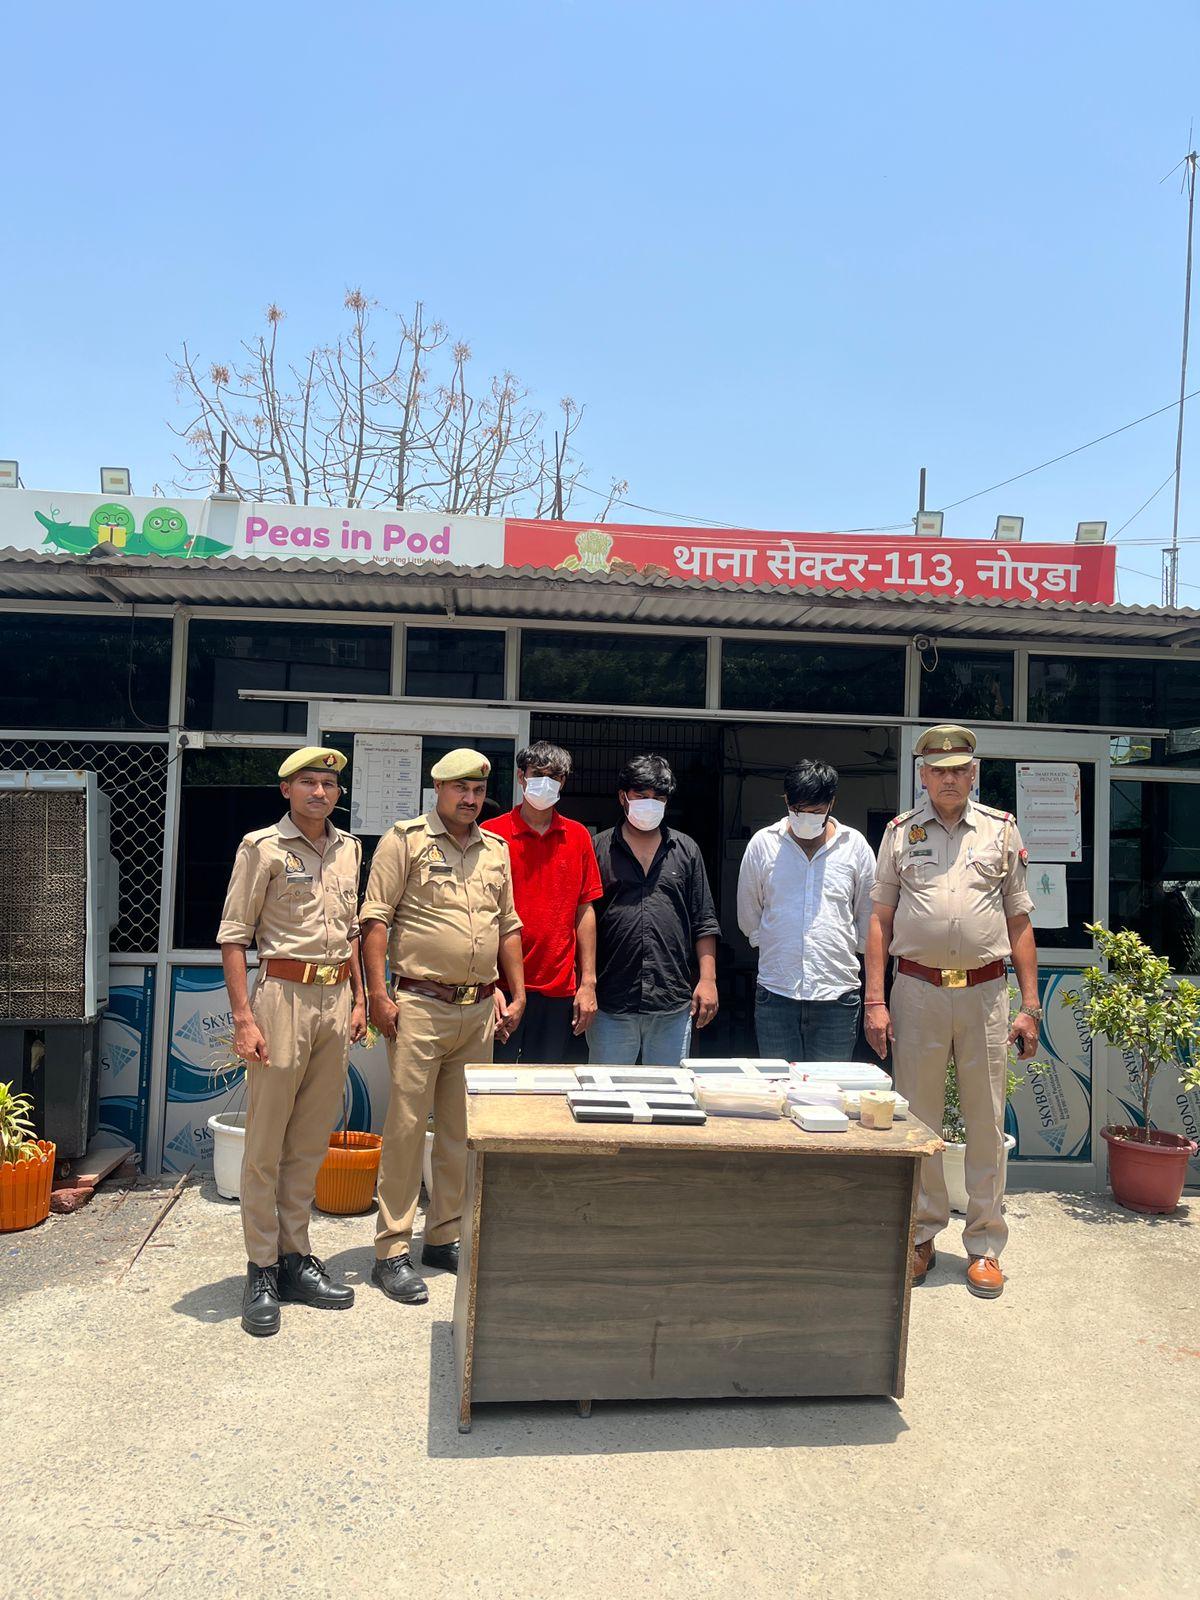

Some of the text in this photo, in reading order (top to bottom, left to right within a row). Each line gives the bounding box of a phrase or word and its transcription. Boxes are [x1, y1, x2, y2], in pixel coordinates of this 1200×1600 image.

[246, 516, 450, 555] Peas in Pod
[372, 555, 406, 564] Nurturing
[673, 539, 1081, 599] थाना सेक्टर-113, नोएडा
[1026, 1063, 1055, 1128] SKYBOND
